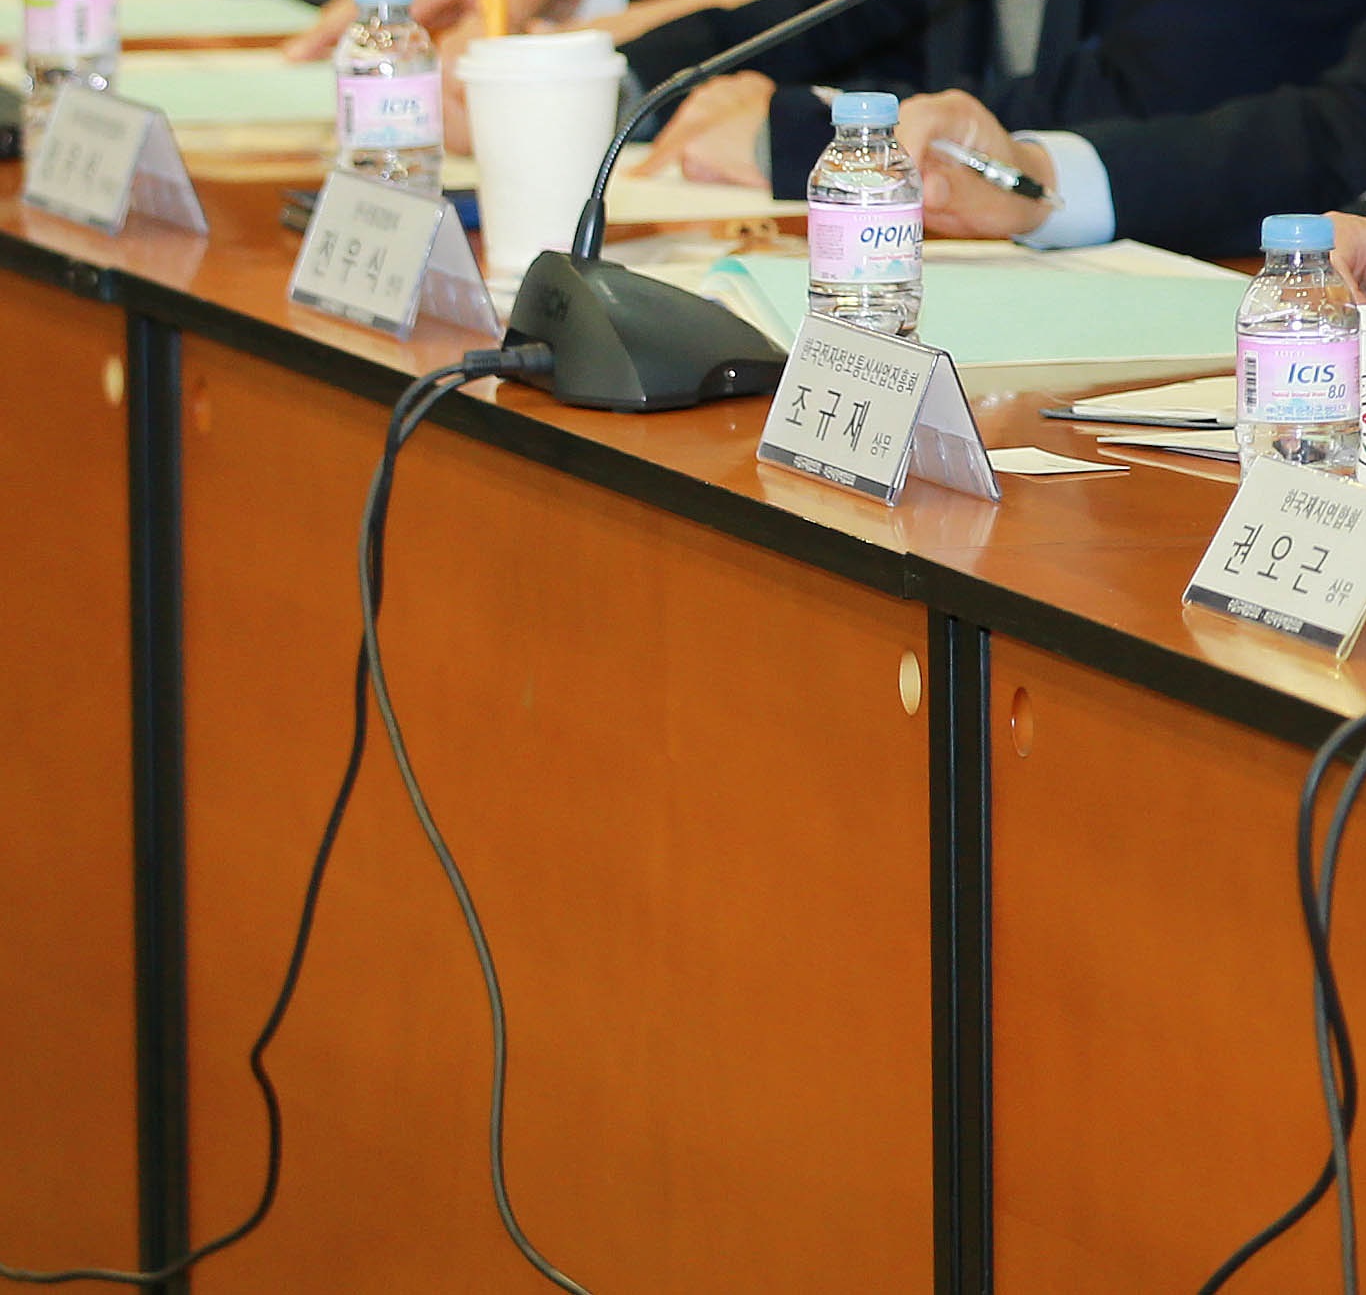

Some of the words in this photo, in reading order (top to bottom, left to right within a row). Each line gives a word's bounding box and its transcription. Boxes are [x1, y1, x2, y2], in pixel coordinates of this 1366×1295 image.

[800, 337, 920, 395] 한국전자정보통신산업진흥회
[1287, 362, 1336, 384] ICIS
[1327, 383, 1346, 399] 8.0
[785, 385, 871, 452] 조규재
[870, 432, 892, 459] 상무
[1281, 488, 1362, 533] 한국제지연합회
[1224, 524, 1331, 594] 권오근
[1325, 578, 1354, 606] 상무
